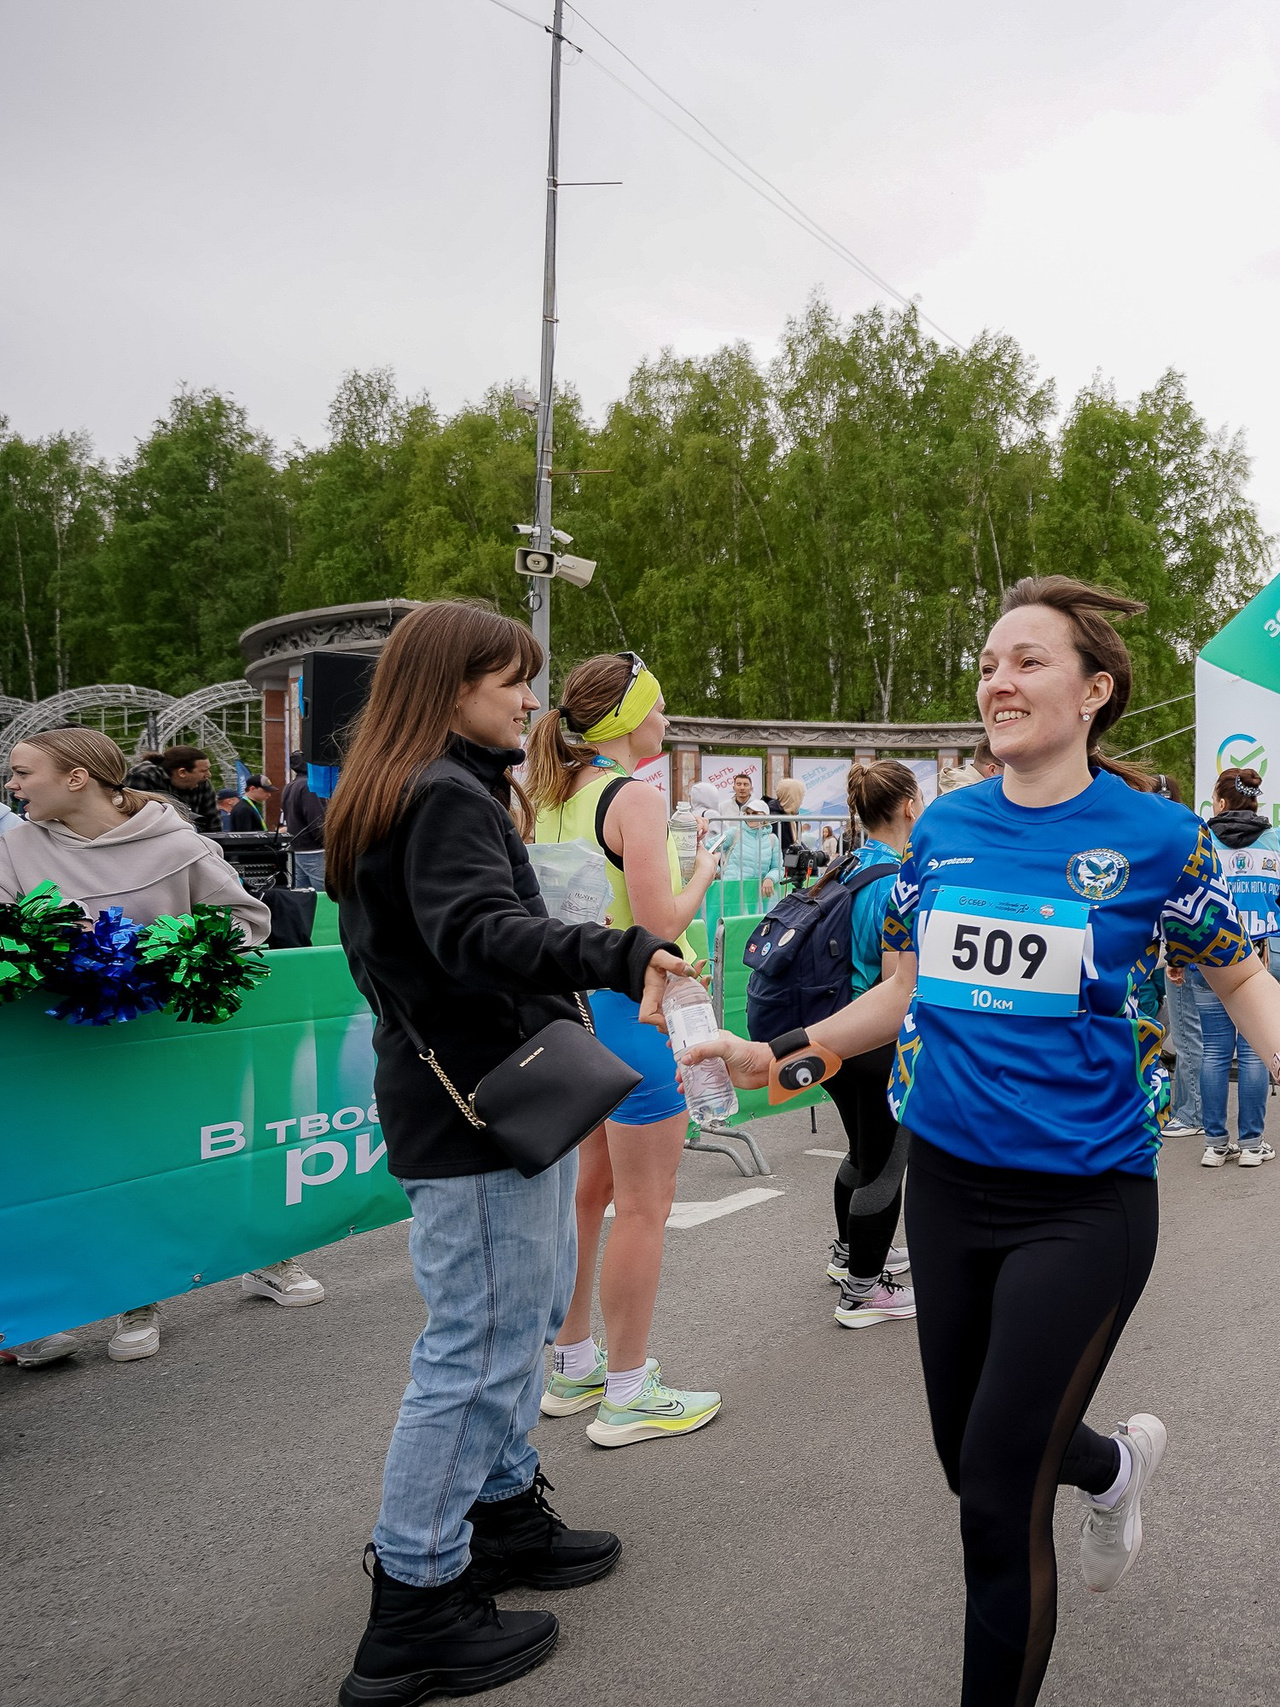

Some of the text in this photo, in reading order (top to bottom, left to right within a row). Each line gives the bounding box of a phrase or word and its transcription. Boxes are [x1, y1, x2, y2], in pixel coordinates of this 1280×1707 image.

[708, 767, 734, 783] БЫТЬ
[952, 924, 1048, 979] 509
[201, 1121, 246, 1160] В
